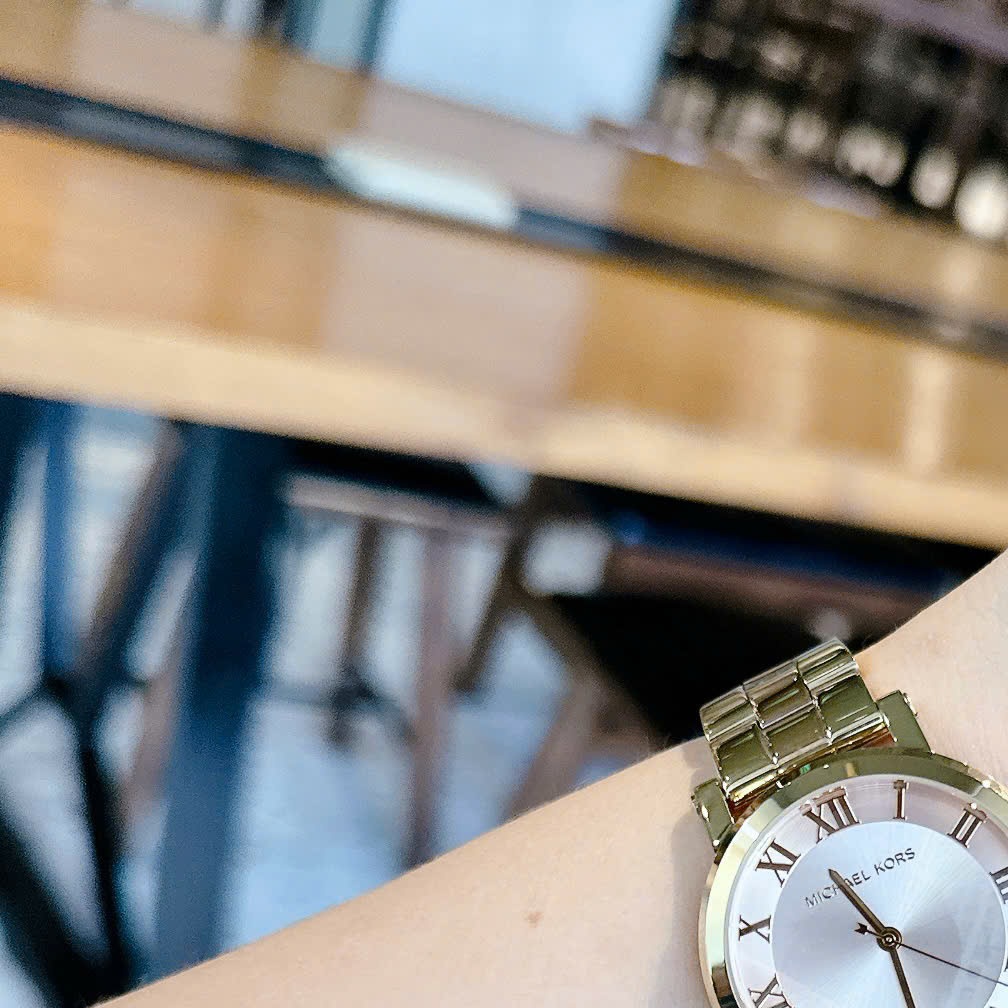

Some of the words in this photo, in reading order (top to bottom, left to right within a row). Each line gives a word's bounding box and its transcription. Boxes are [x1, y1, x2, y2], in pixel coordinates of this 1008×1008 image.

[802, 787, 861, 843] XII
[893, 780, 908, 820] I
[947, 803, 987, 848] II
[755, 838, 801, 887] XI
[873, 847, 916, 875] KORS
[738, 914, 772, 944] X
